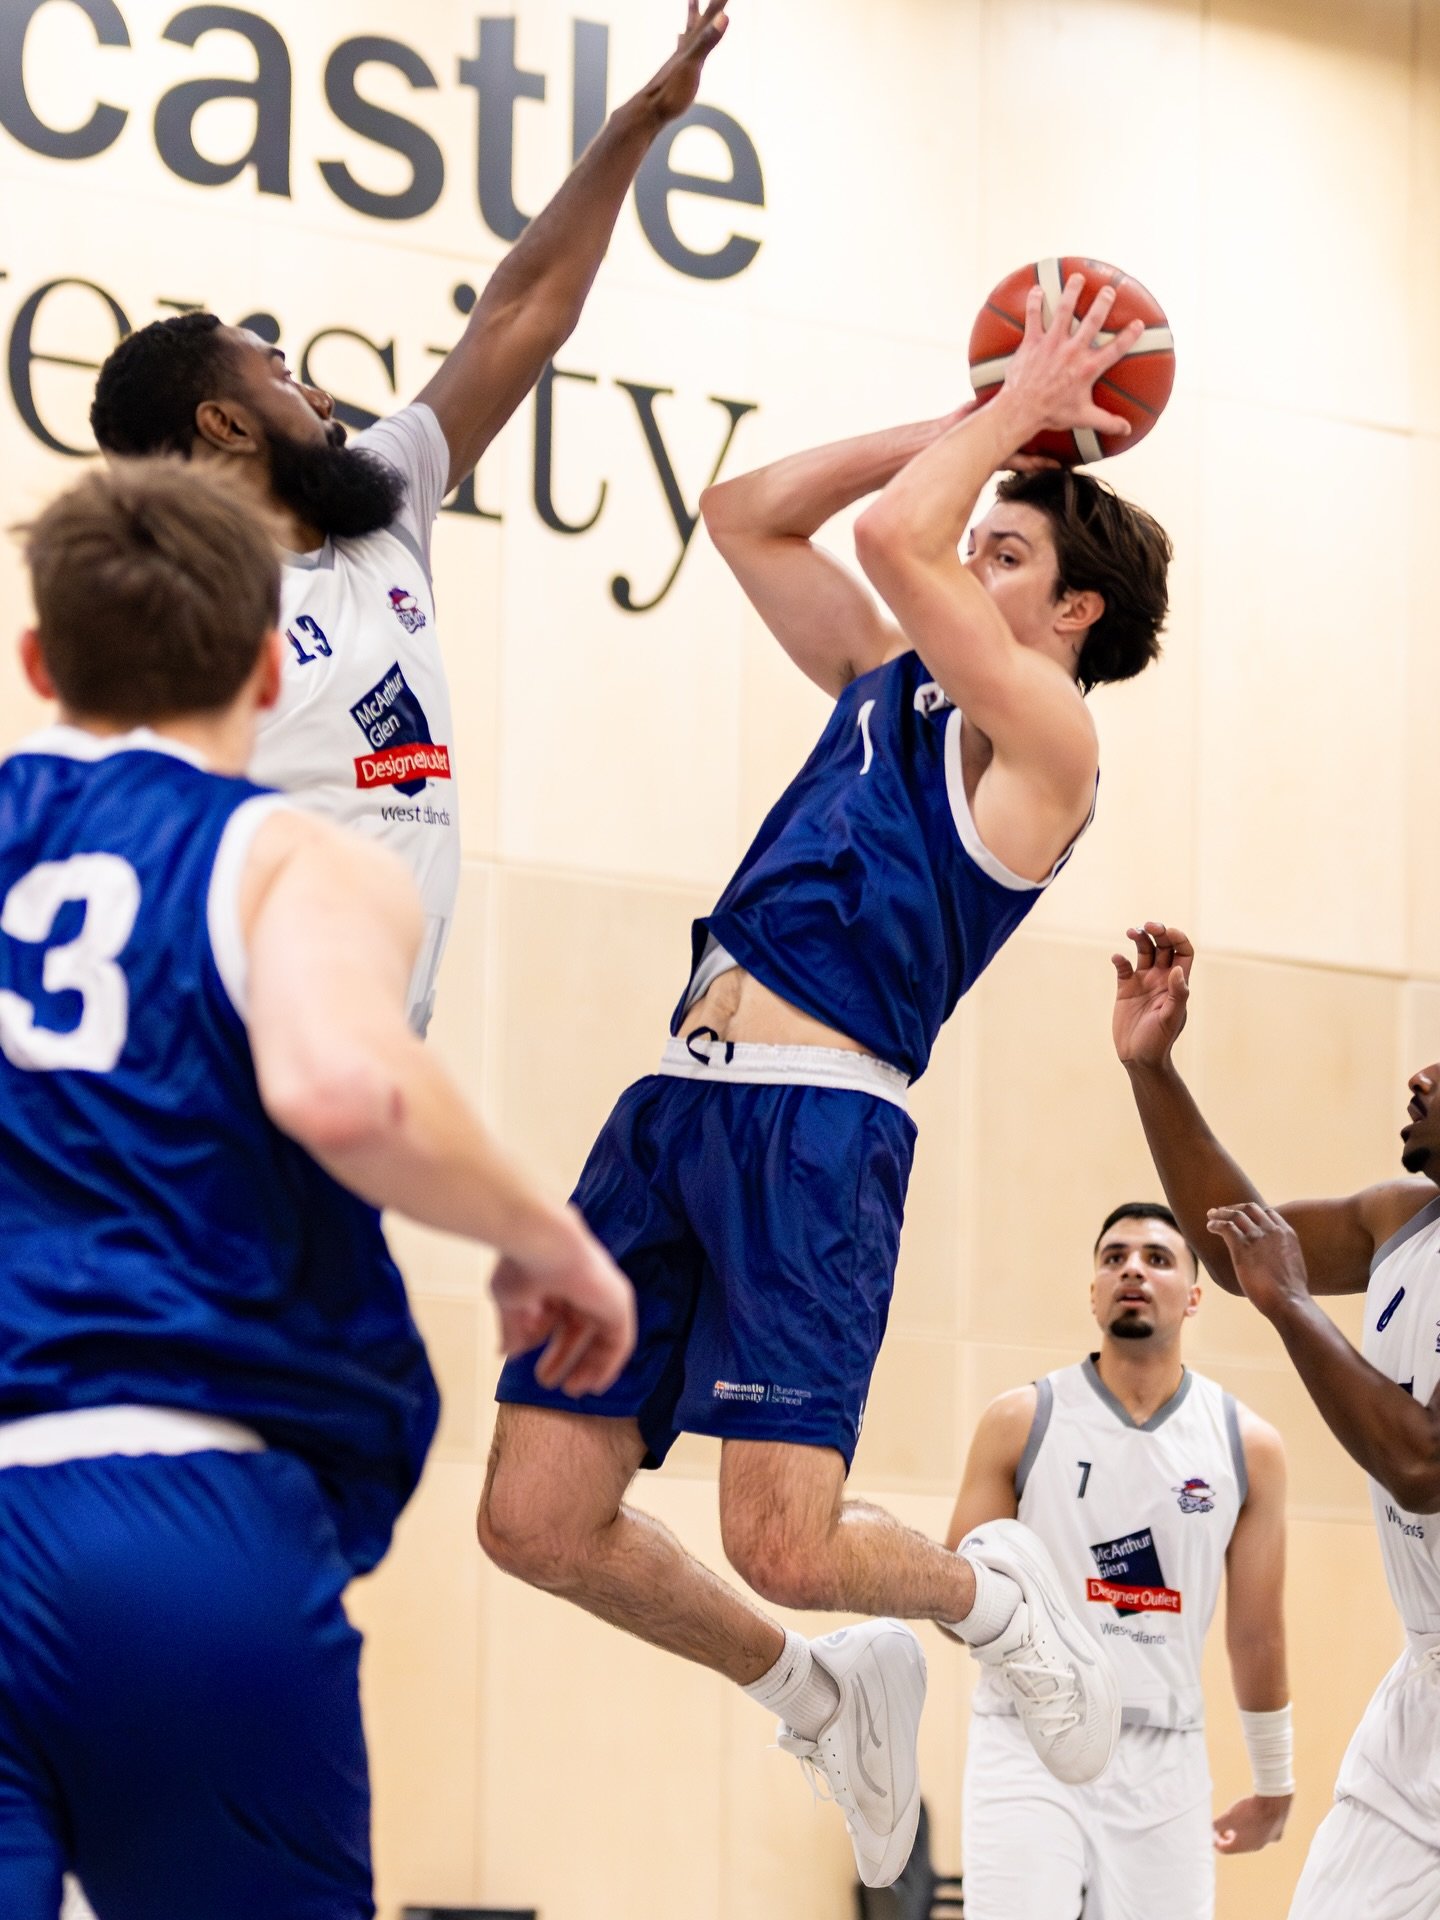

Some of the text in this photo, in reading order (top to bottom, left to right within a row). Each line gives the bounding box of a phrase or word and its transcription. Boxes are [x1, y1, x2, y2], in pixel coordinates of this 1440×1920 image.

[286, 614, 332, 666] 13
[355, 672, 404, 729] McArthur
[369, 714, 401, 748] Glen
[381, 805, 421, 822] West
[0, 852, 141, 1073] 3
[1077, 1461, 1092, 1499] 7
[1090, 1534, 1151, 1562] McArthur
[1141, 1588, 1178, 1608] Outlet
